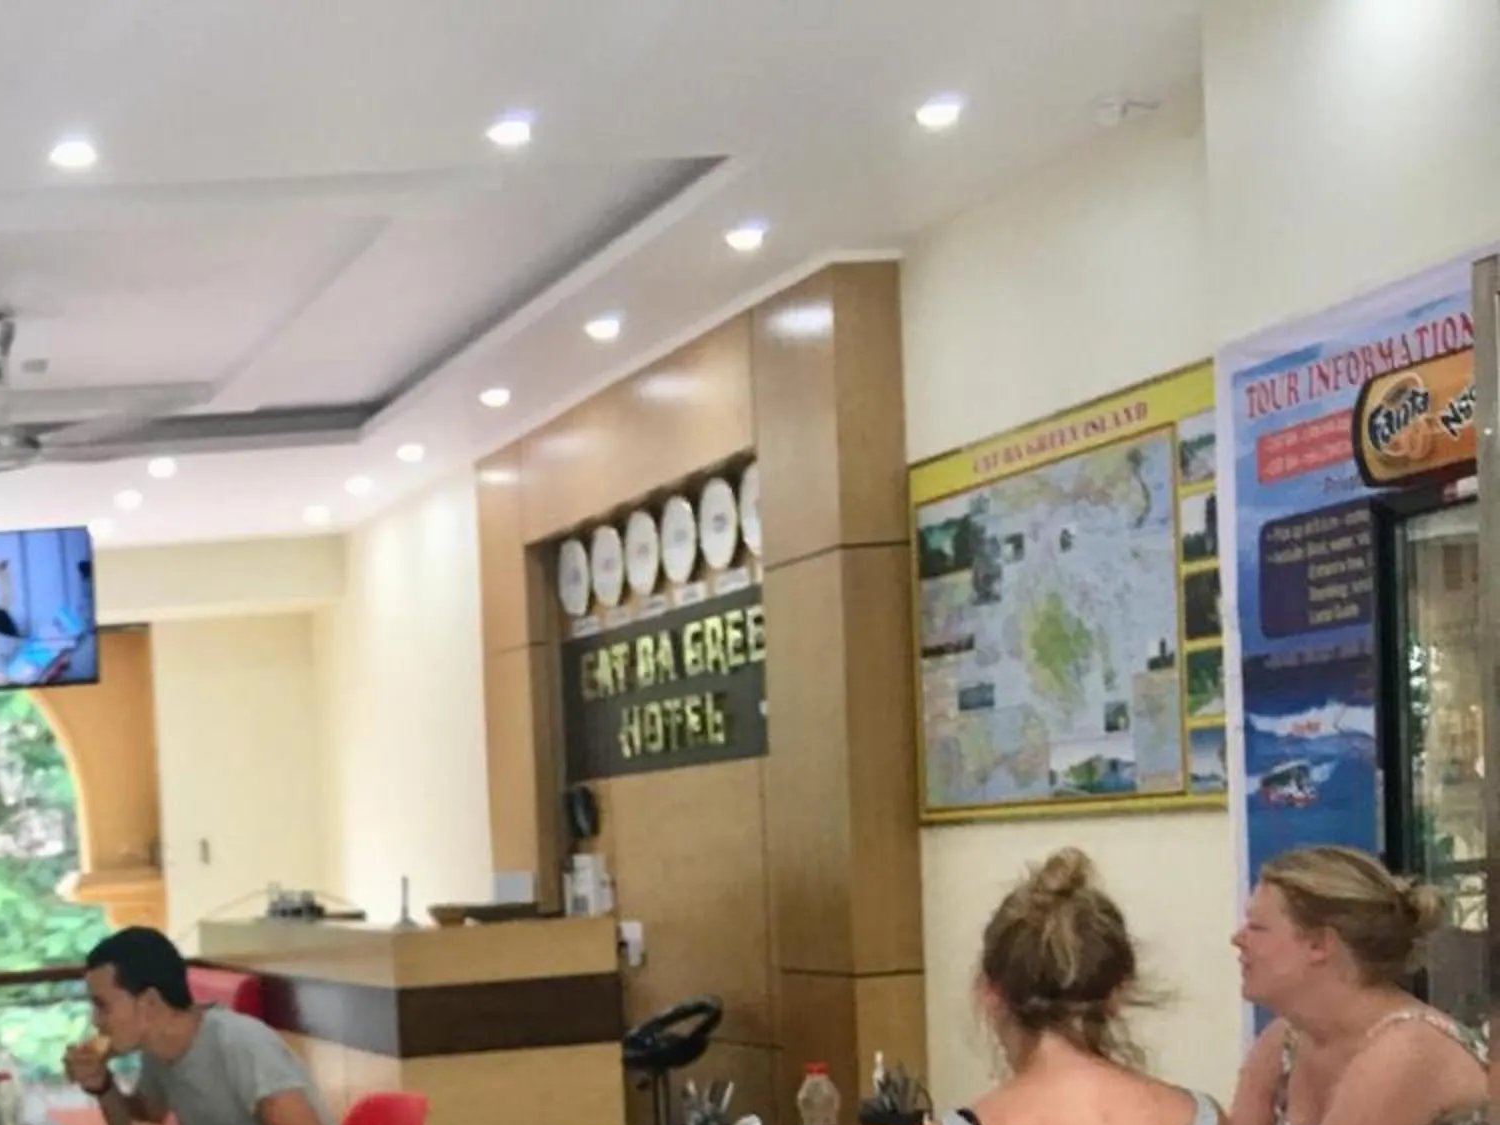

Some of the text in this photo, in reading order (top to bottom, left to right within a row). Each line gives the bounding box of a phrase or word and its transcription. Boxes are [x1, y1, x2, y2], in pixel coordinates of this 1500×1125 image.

[1246, 311, 1476, 419] TOUR INFORMATION
[1367, 389, 1430, 452] Fanta
[618, 691, 726, 759] HOTEL
